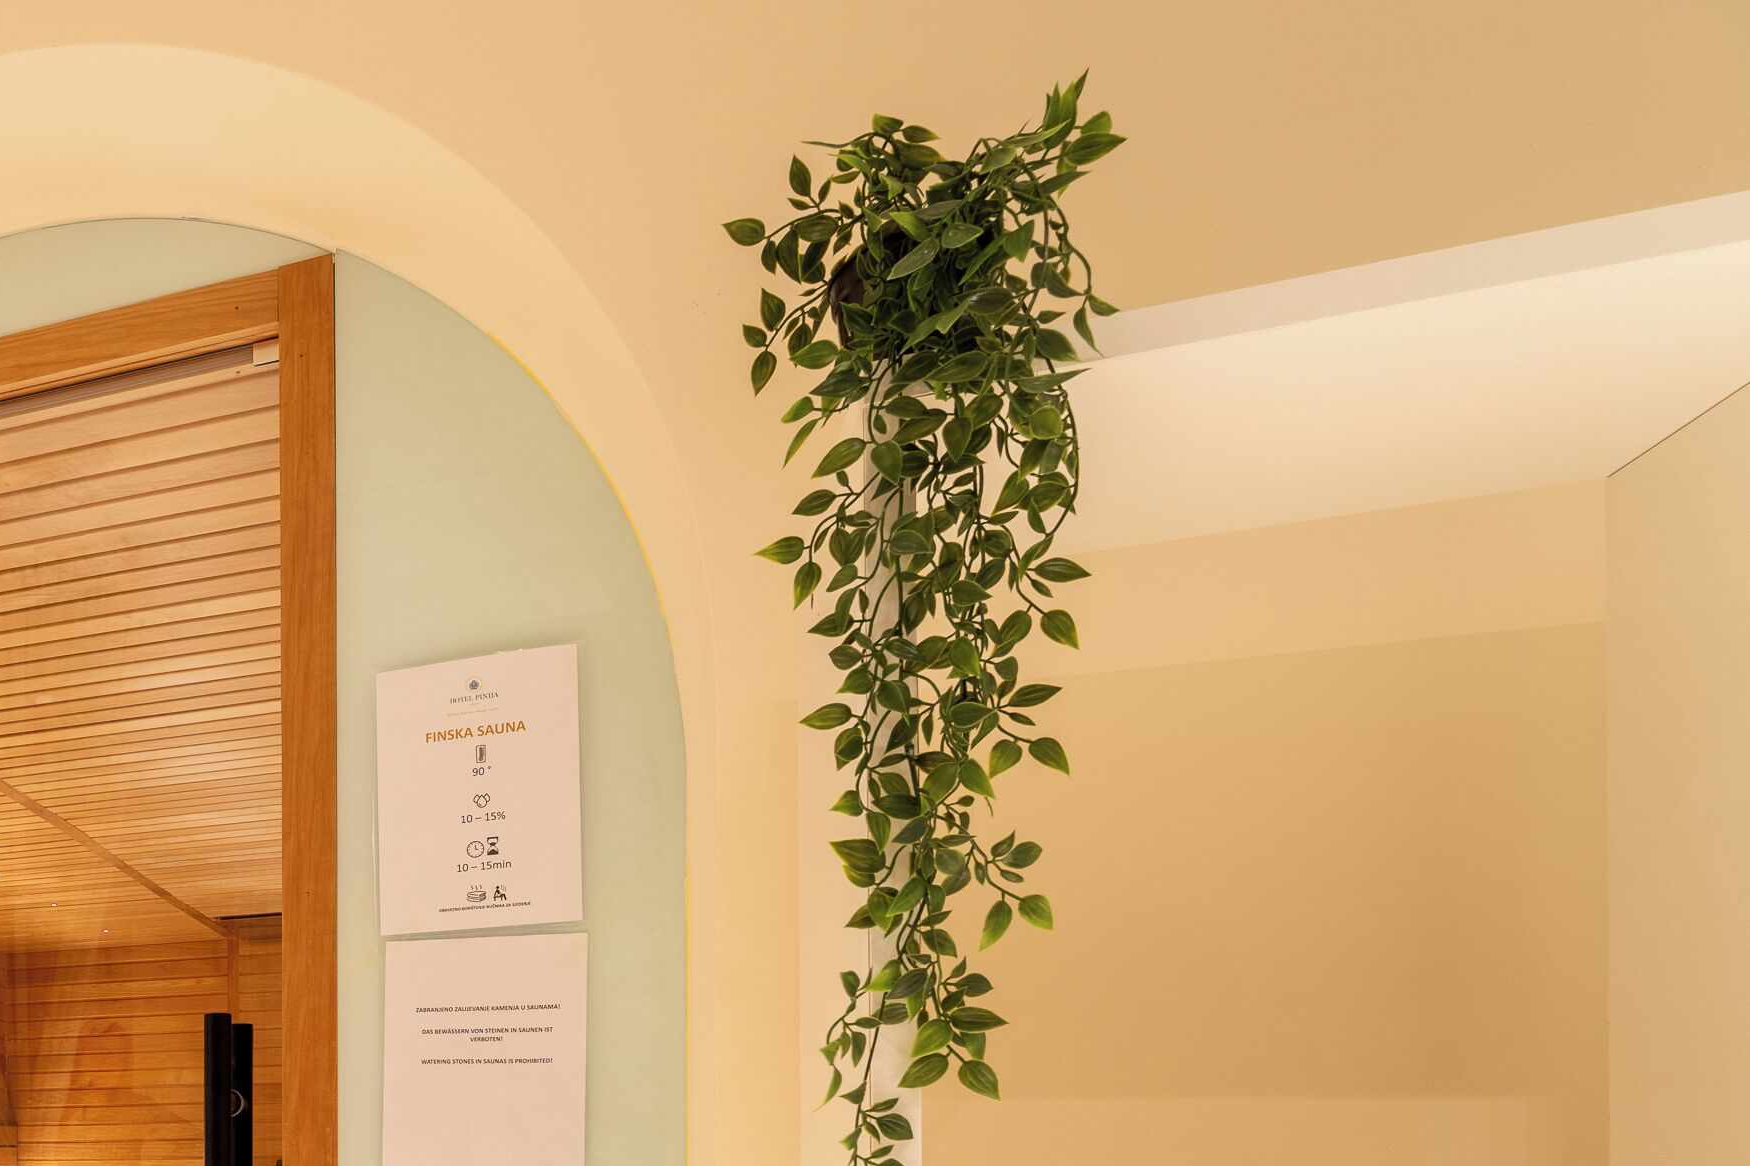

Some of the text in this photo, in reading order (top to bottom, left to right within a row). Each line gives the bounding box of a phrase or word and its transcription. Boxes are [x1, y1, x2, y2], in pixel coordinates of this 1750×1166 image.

[425, 720, 527, 743] FINSKA SAUNA
[472, 766, 485, 776] 90
[460, 814, 473, 824] 10
[484, 811, 506, 822] 15%
[456, 863, 469, 873] 10
[480, 859, 512, 871] 15min
